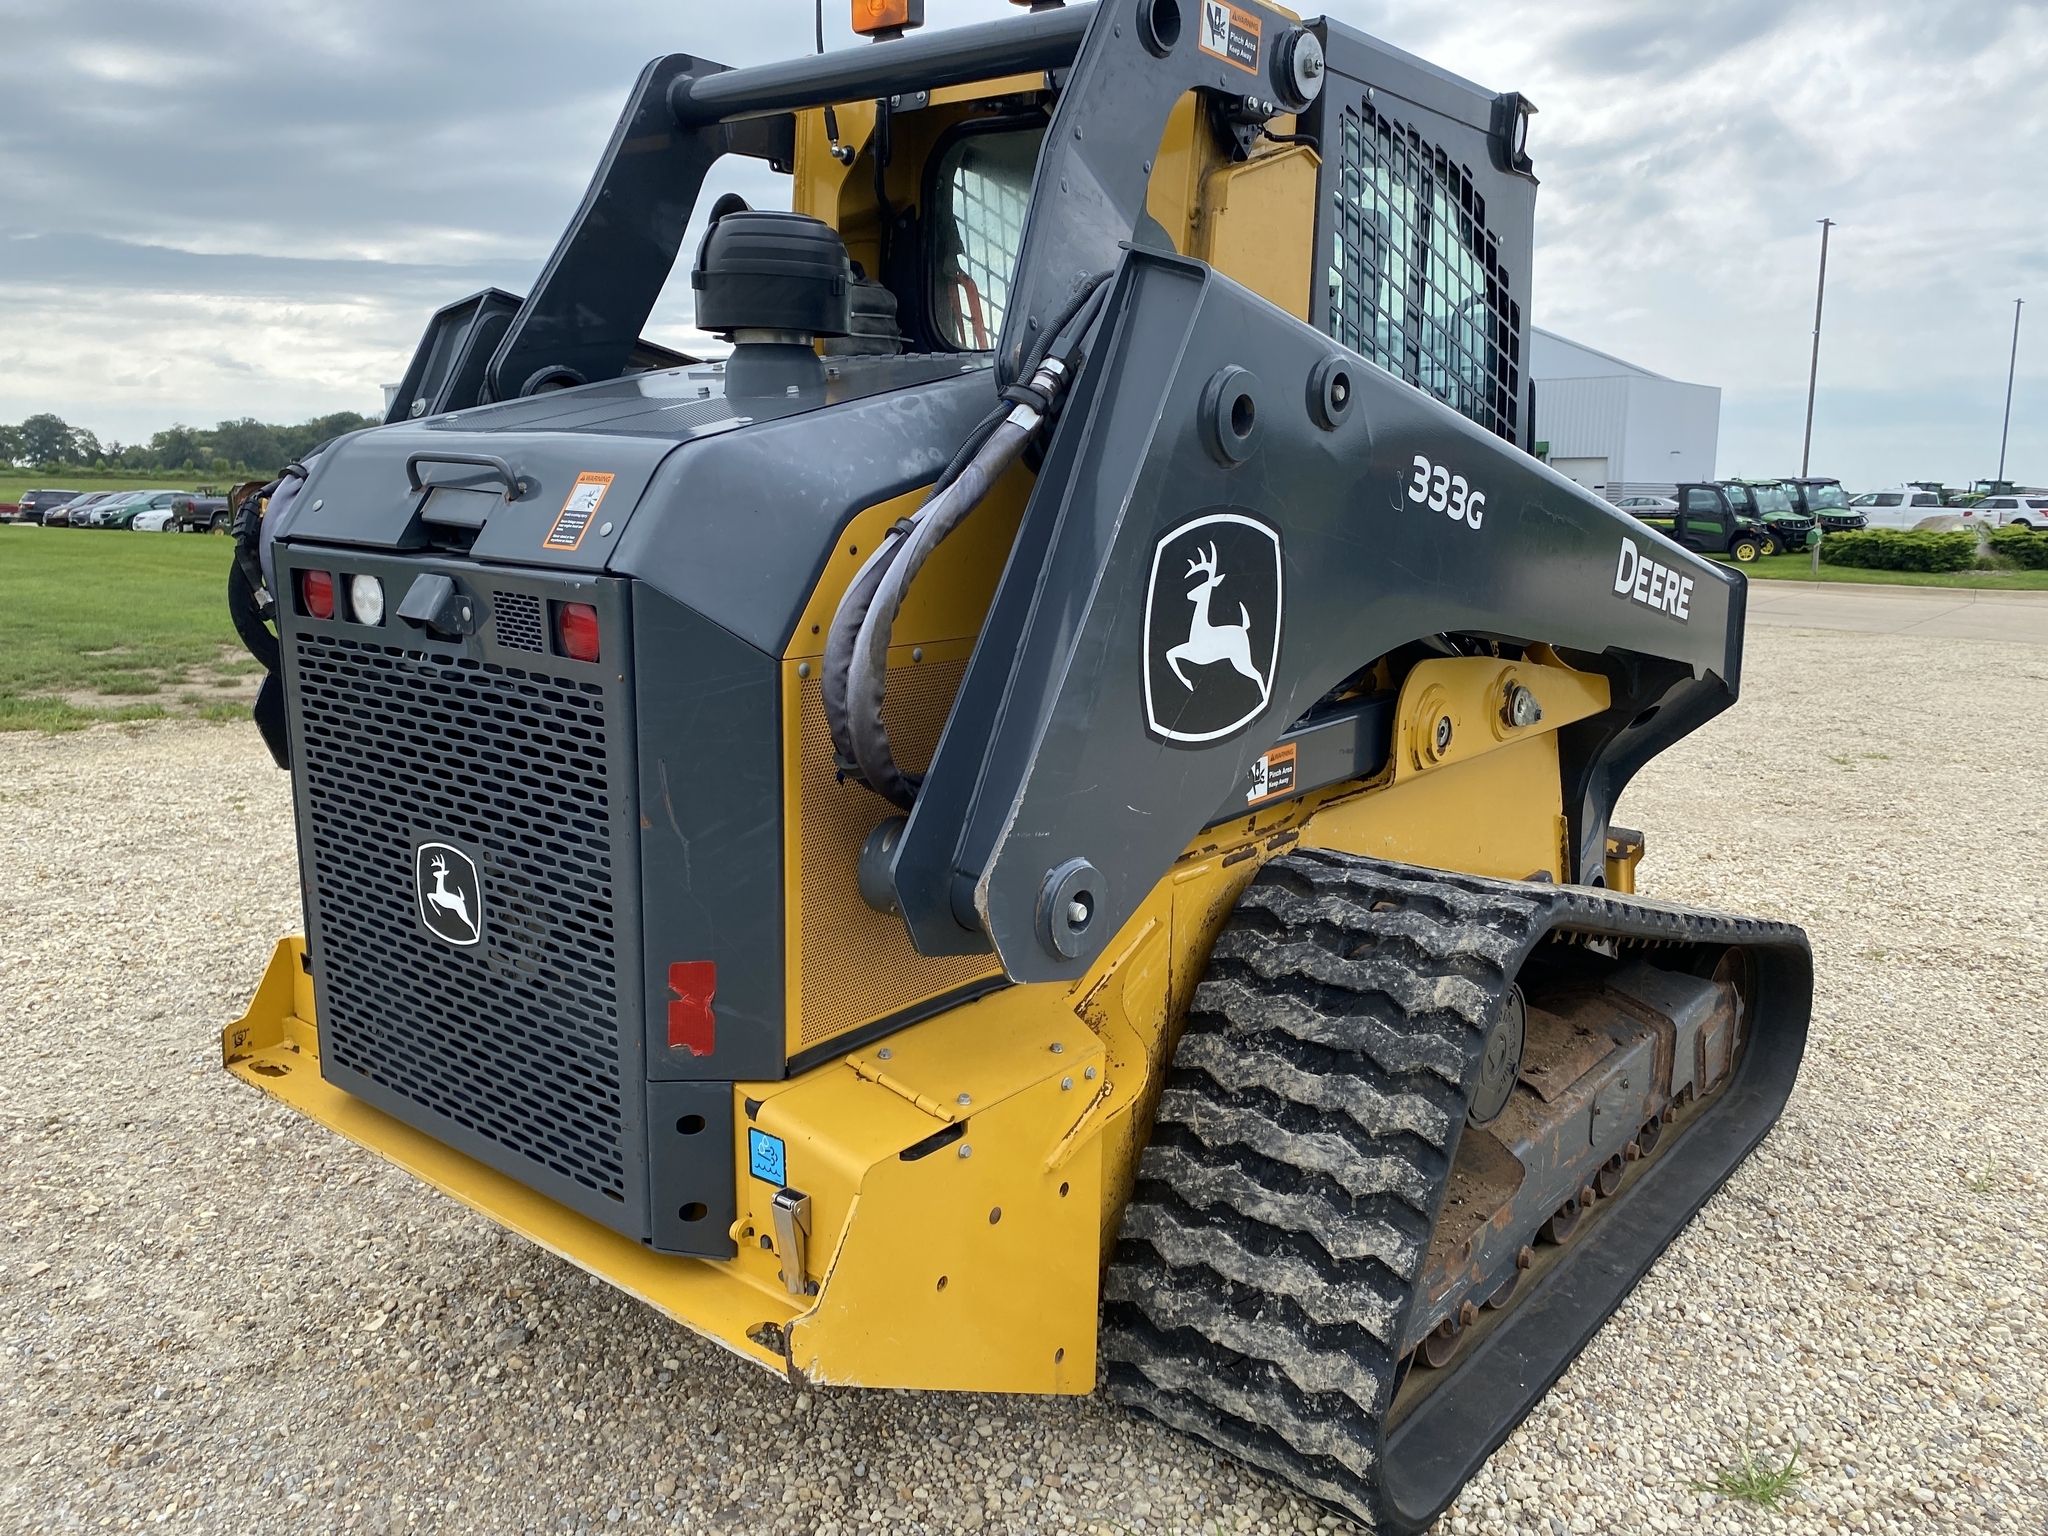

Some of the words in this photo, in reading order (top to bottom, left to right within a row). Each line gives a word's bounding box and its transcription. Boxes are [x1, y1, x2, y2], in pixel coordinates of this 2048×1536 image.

[1237, 15, 1259, 32] WARNING
[1230, 31, 1245, 46] Pinch
[1244, 38, 1257, 51] Area
[1229, 43, 1240, 56] Keep
[1240, 49, 1252, 62] Away
[585, 474, 612, 483] WARNING
[1408, 455, 1486, 530] 333G
[1614, 536, 1694, 620] DEERE
[1274, 748, 1294, 760] WARNING
[1268, 769, 1281, 780] Pinch
[1281, 766, 1293, 775] Area
[1268, 780, 1279, 789] Keep
[1278, 777, 1290, 786] Away
